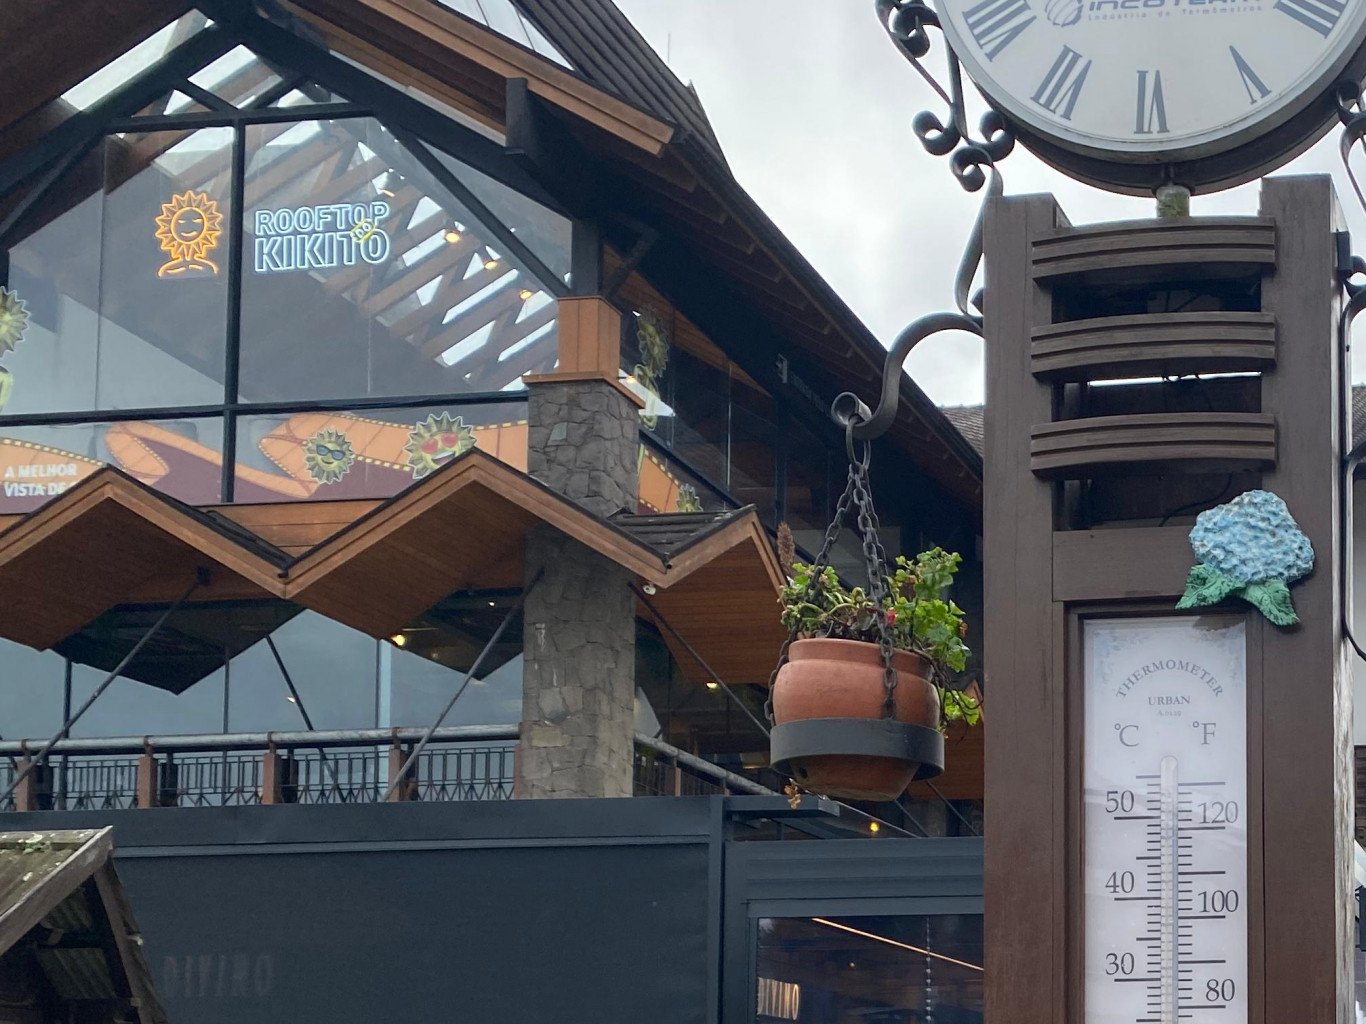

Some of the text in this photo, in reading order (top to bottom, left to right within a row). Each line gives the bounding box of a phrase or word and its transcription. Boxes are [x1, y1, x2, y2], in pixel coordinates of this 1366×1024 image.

[255, 202, 390, 236] ROOFTOP
[255, 229, 390, 272] KIKITO
[4, 463, 78, 478] A MELHOR
[4, 482, 45, 497] VISTA
[1115, 659, 1223, 699] THERMOMETER
[1148, 695, 1191, 706] URBAN
[1114, 723, 1139, 747] °C
[1192, 721, 1216, 745] °F
[1105, 790, 1134, 813] 50
[1198, 801, 1238, 824] 120
[1105, 871, 1134, 893] 40
[1198, 890, 1238, 912] 100
[1105, 953, 1134, 975] 30
[1206, 978, 1235, 1001] 80
